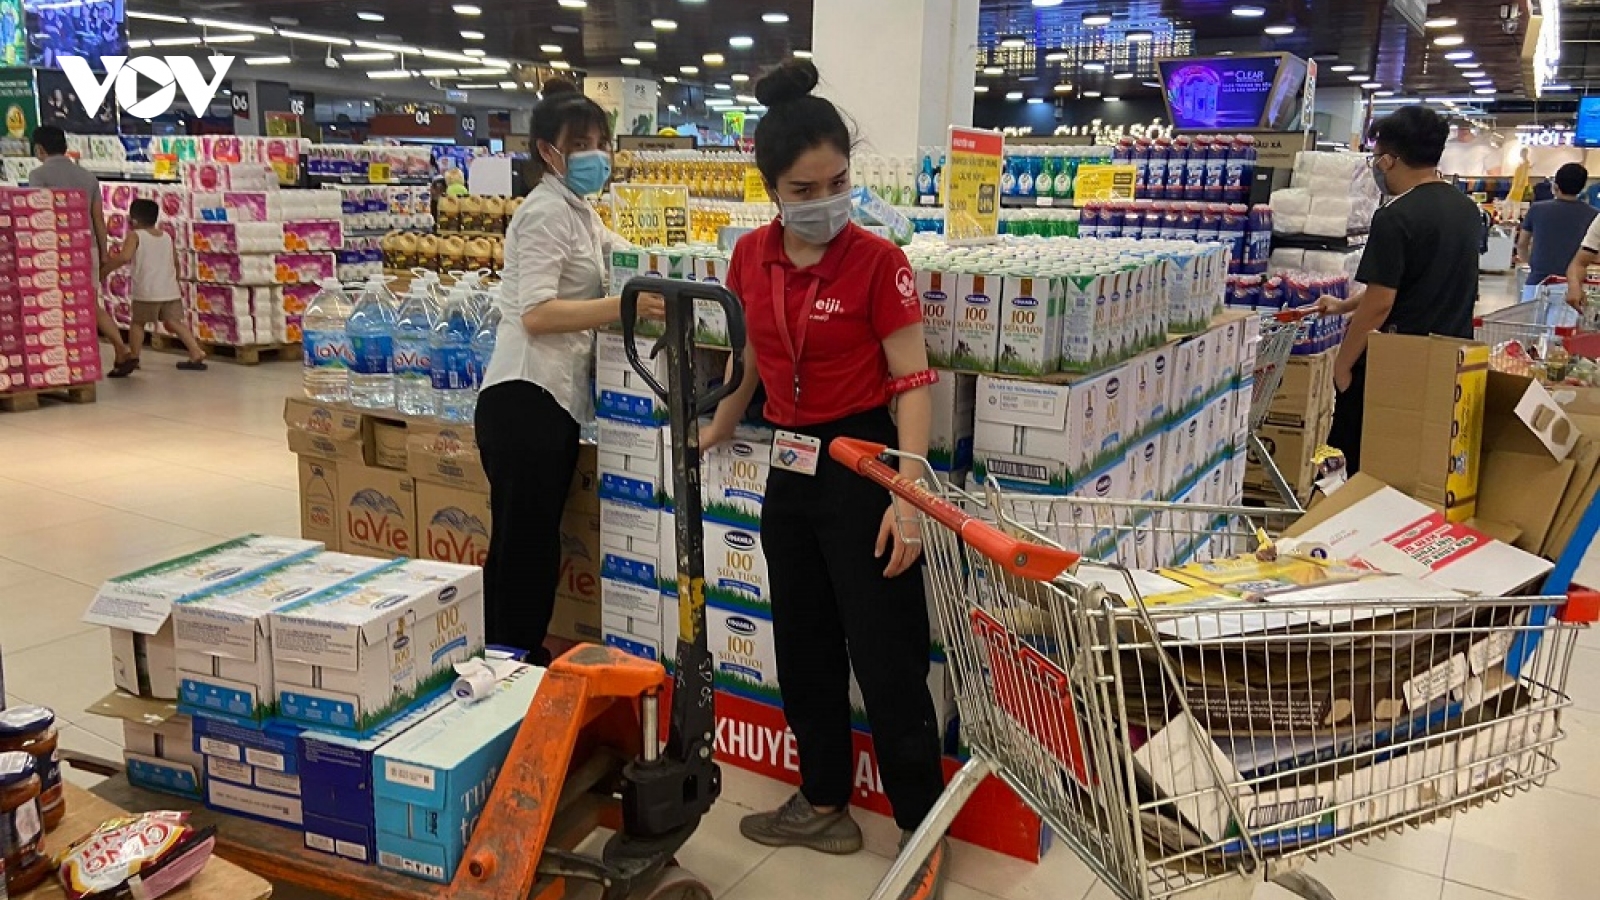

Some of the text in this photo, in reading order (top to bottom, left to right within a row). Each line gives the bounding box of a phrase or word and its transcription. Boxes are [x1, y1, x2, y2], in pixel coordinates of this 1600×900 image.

[1236, 70, 1264, 80] CLEAR
[233, 94, 248, 111] 06
[291, 99, 305, 115] 05
[415, 110, 431, 126] 04
[461, 116, 475, 131] 03
[1515, 129, 1559, 147] THỜI
[347, 509, 410, 551] laVie
